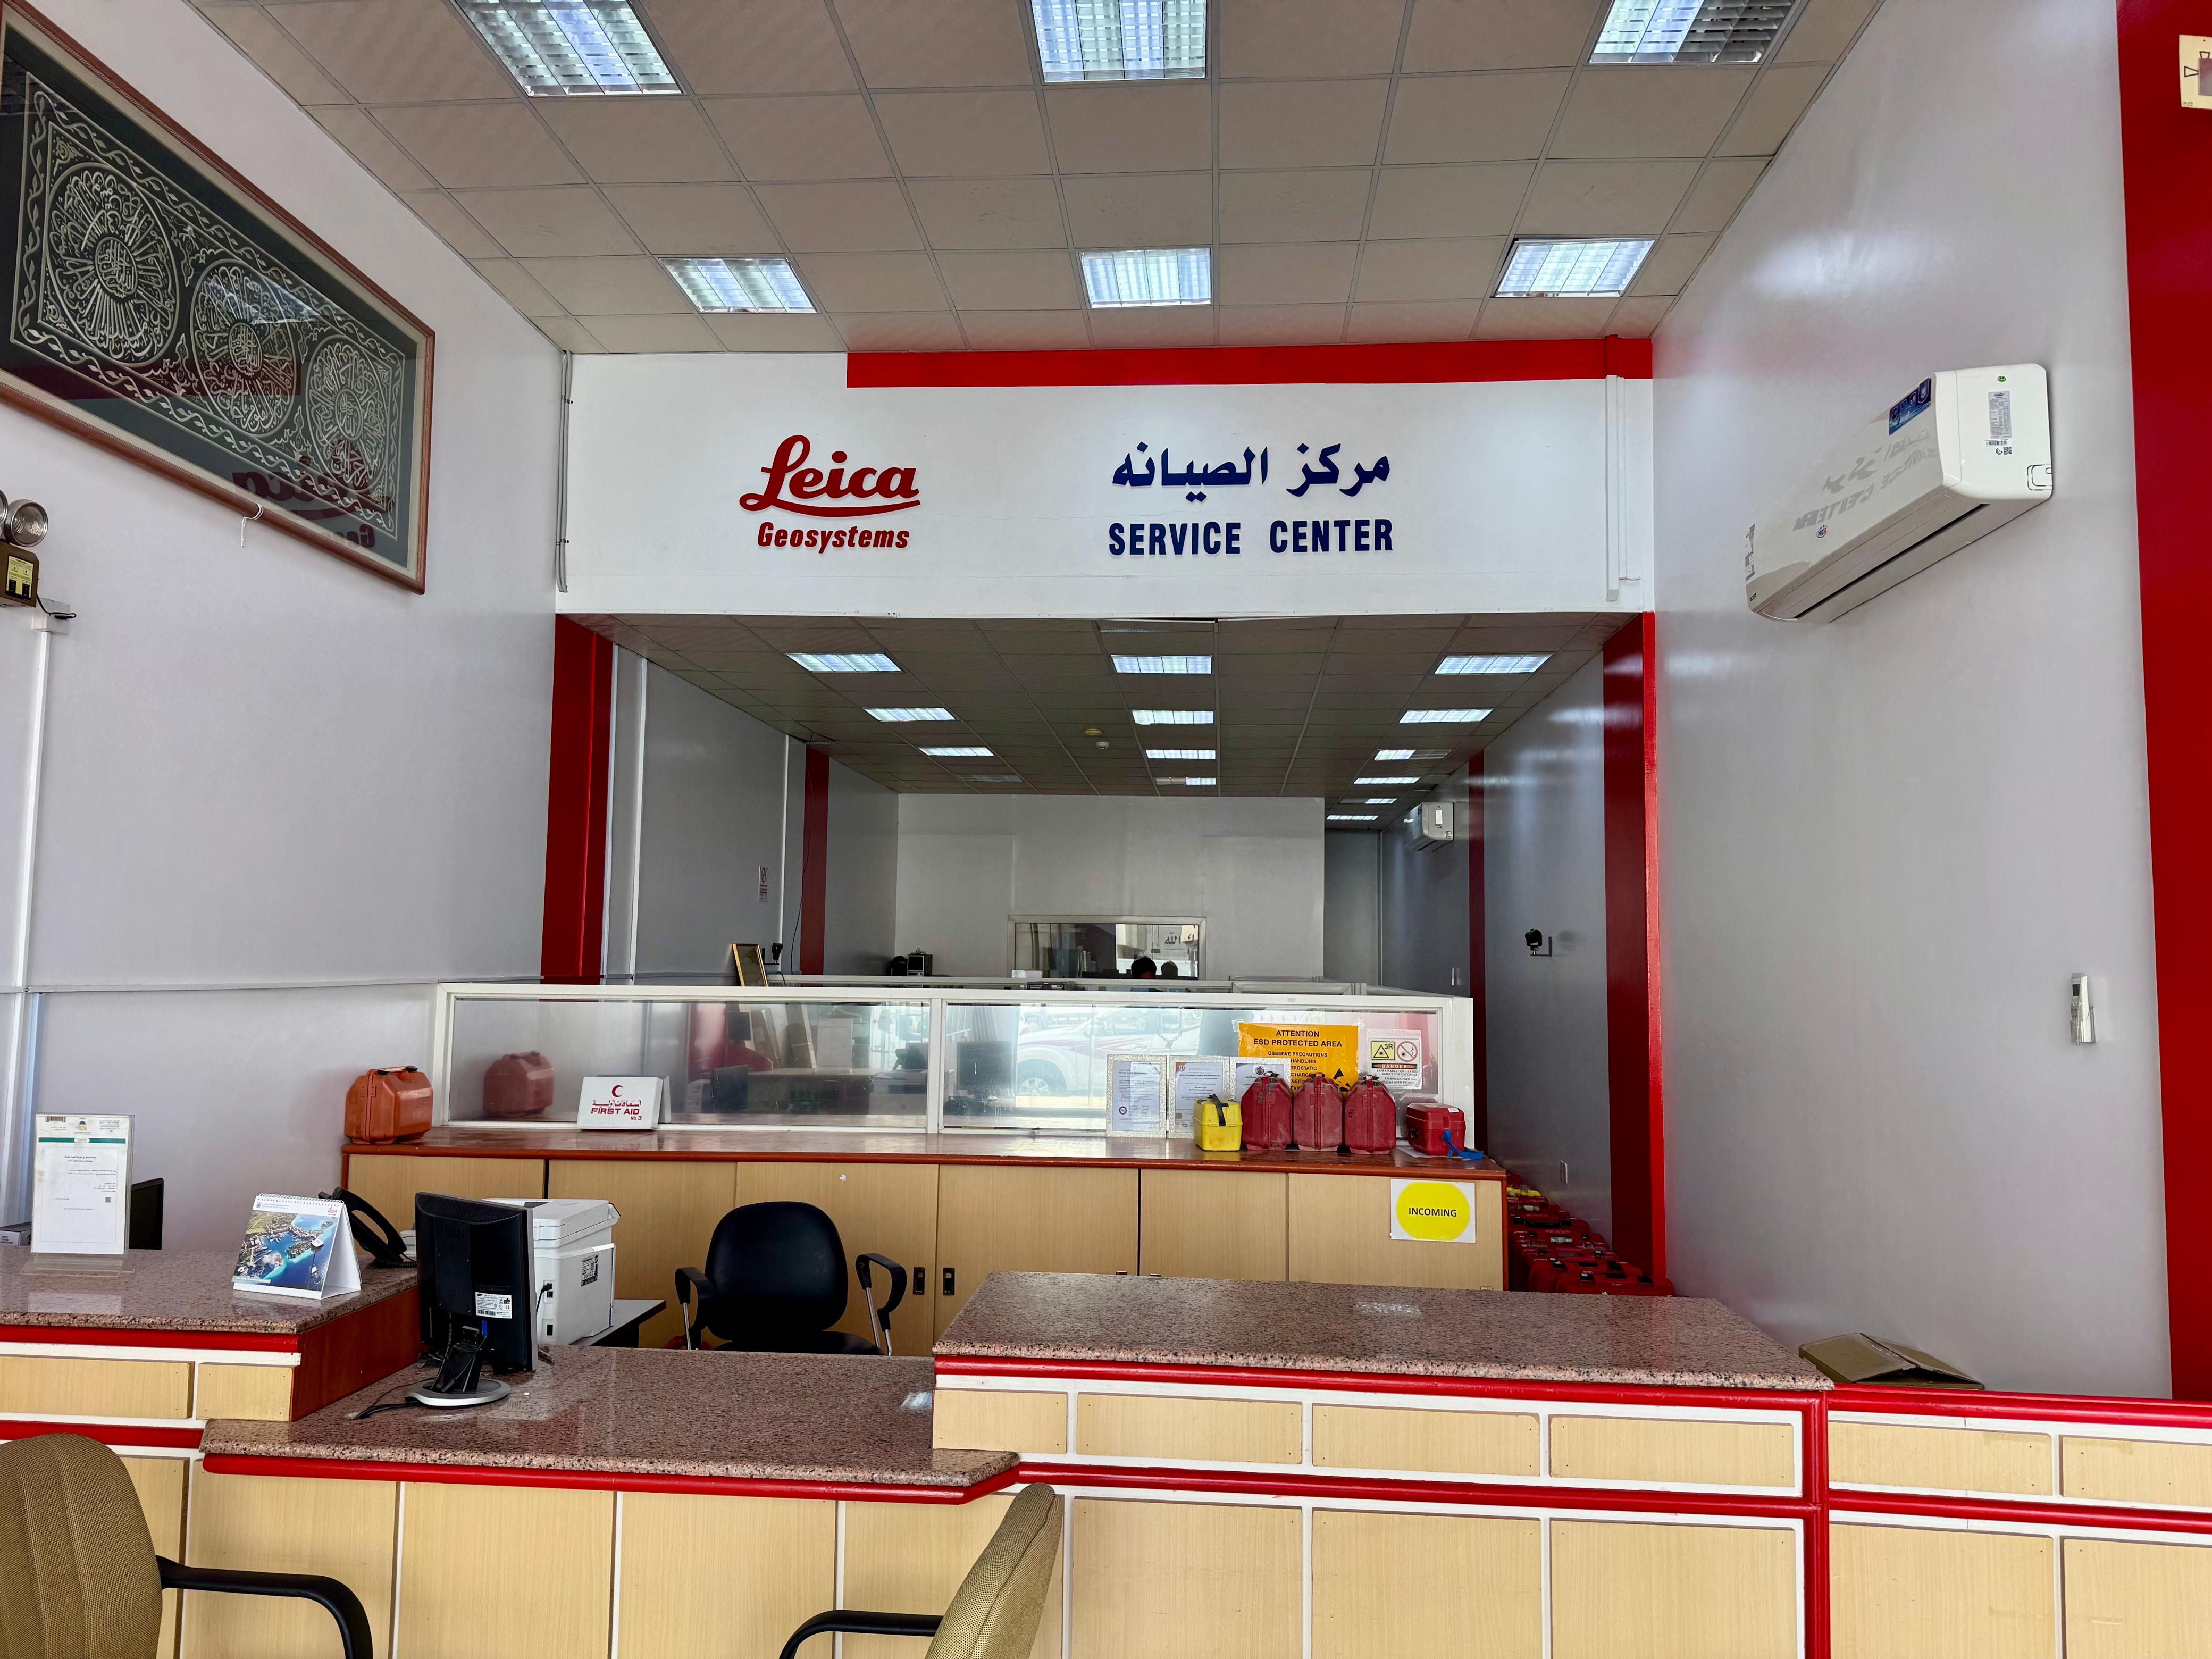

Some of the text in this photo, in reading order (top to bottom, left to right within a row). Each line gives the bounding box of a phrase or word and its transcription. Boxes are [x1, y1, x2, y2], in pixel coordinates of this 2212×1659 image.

[740, 434, 921, 518] Leica
[1285, 442, 1391, 498] مركز
[757, 522, 910, 554] Geosystems
[1109, 518, 1394, 556] SERVICE CENTER
[1409, 1207, 1457, 1217] INCOMING
